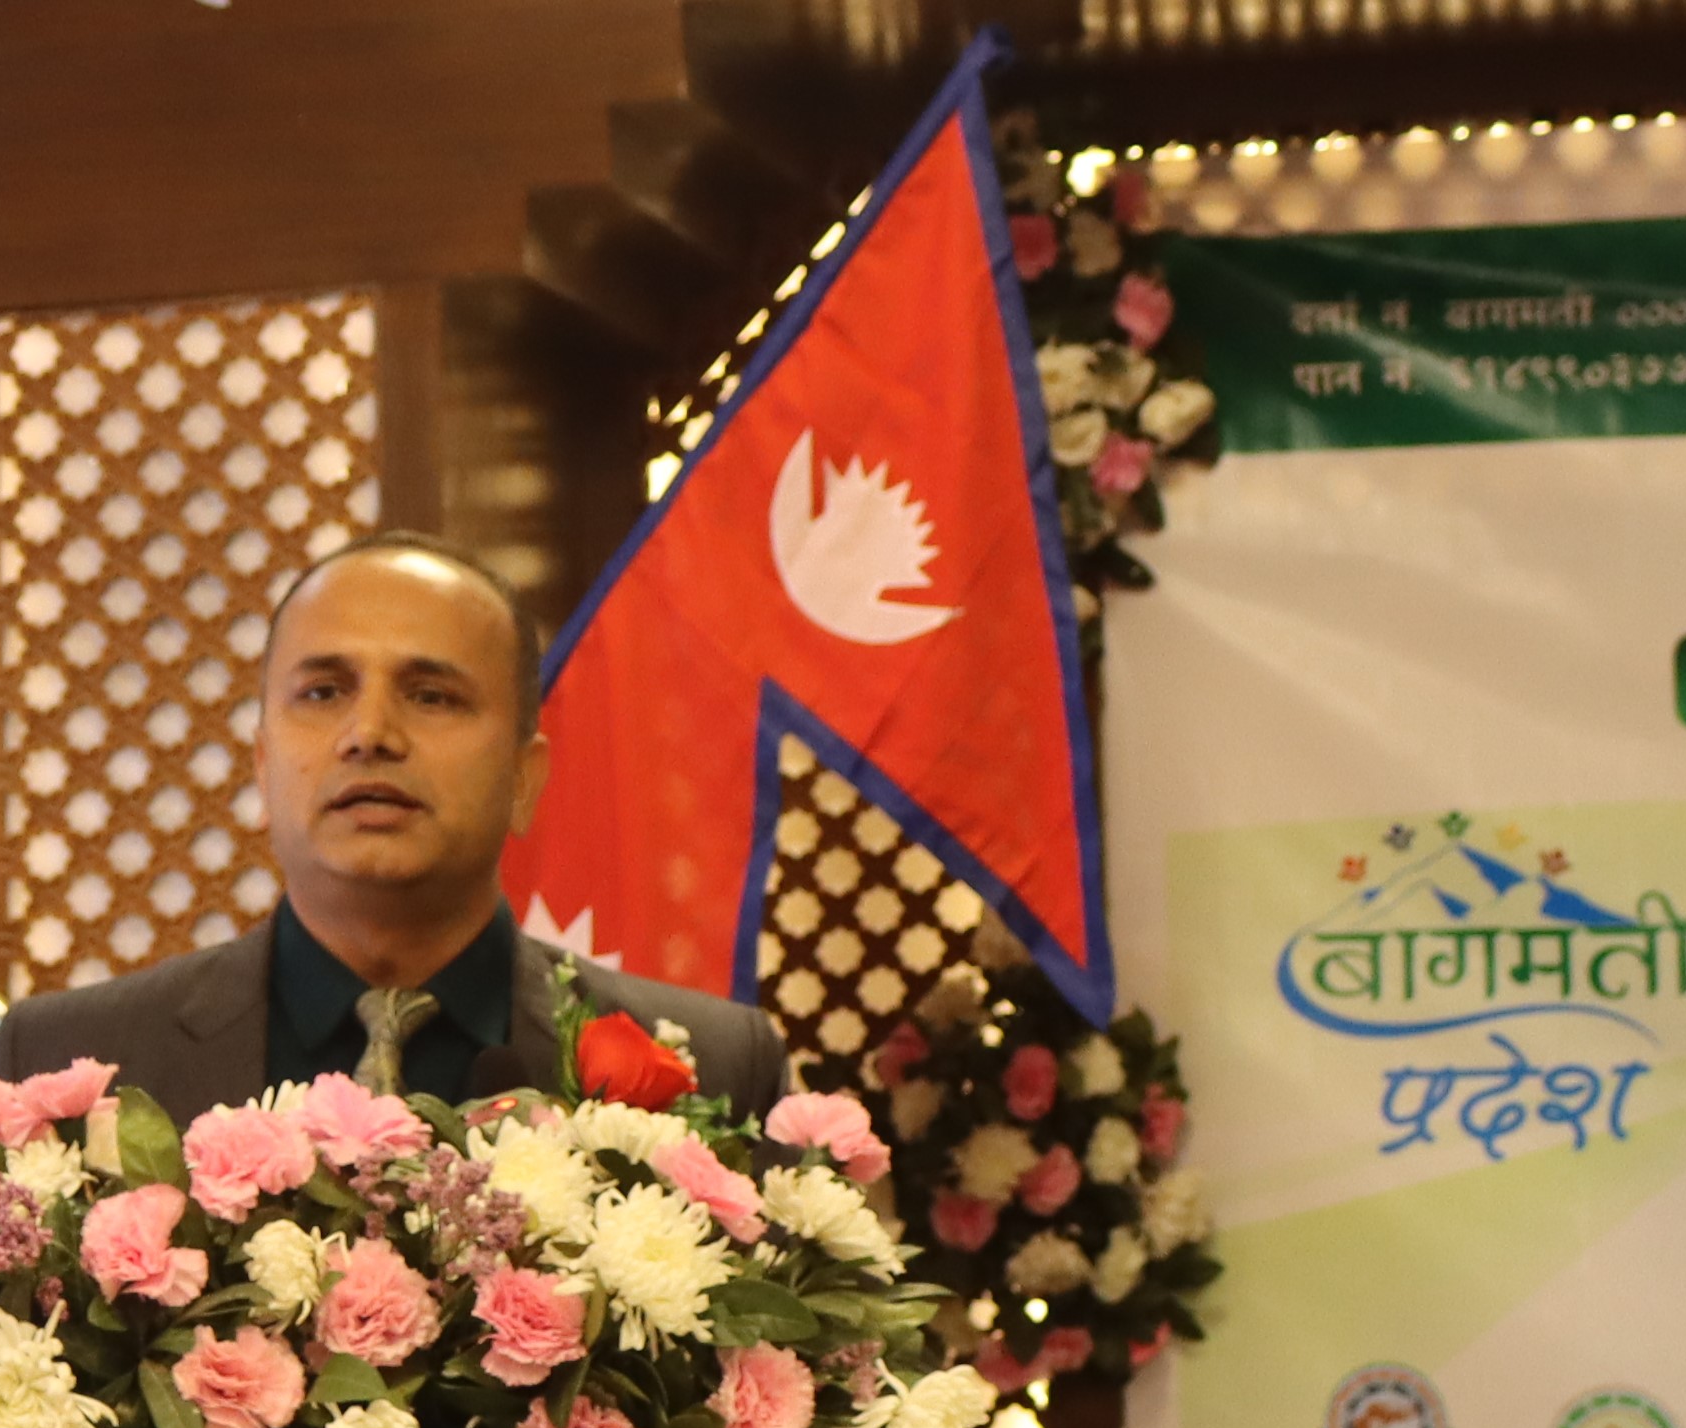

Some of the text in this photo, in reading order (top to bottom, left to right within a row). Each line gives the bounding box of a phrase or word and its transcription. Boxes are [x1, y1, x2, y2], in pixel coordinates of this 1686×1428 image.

[1445, 286, 1594, 329] बागमती
[1293, 361, 1362, 396] पान
[1377, 1034, 1651, 1160] प्रदेश
